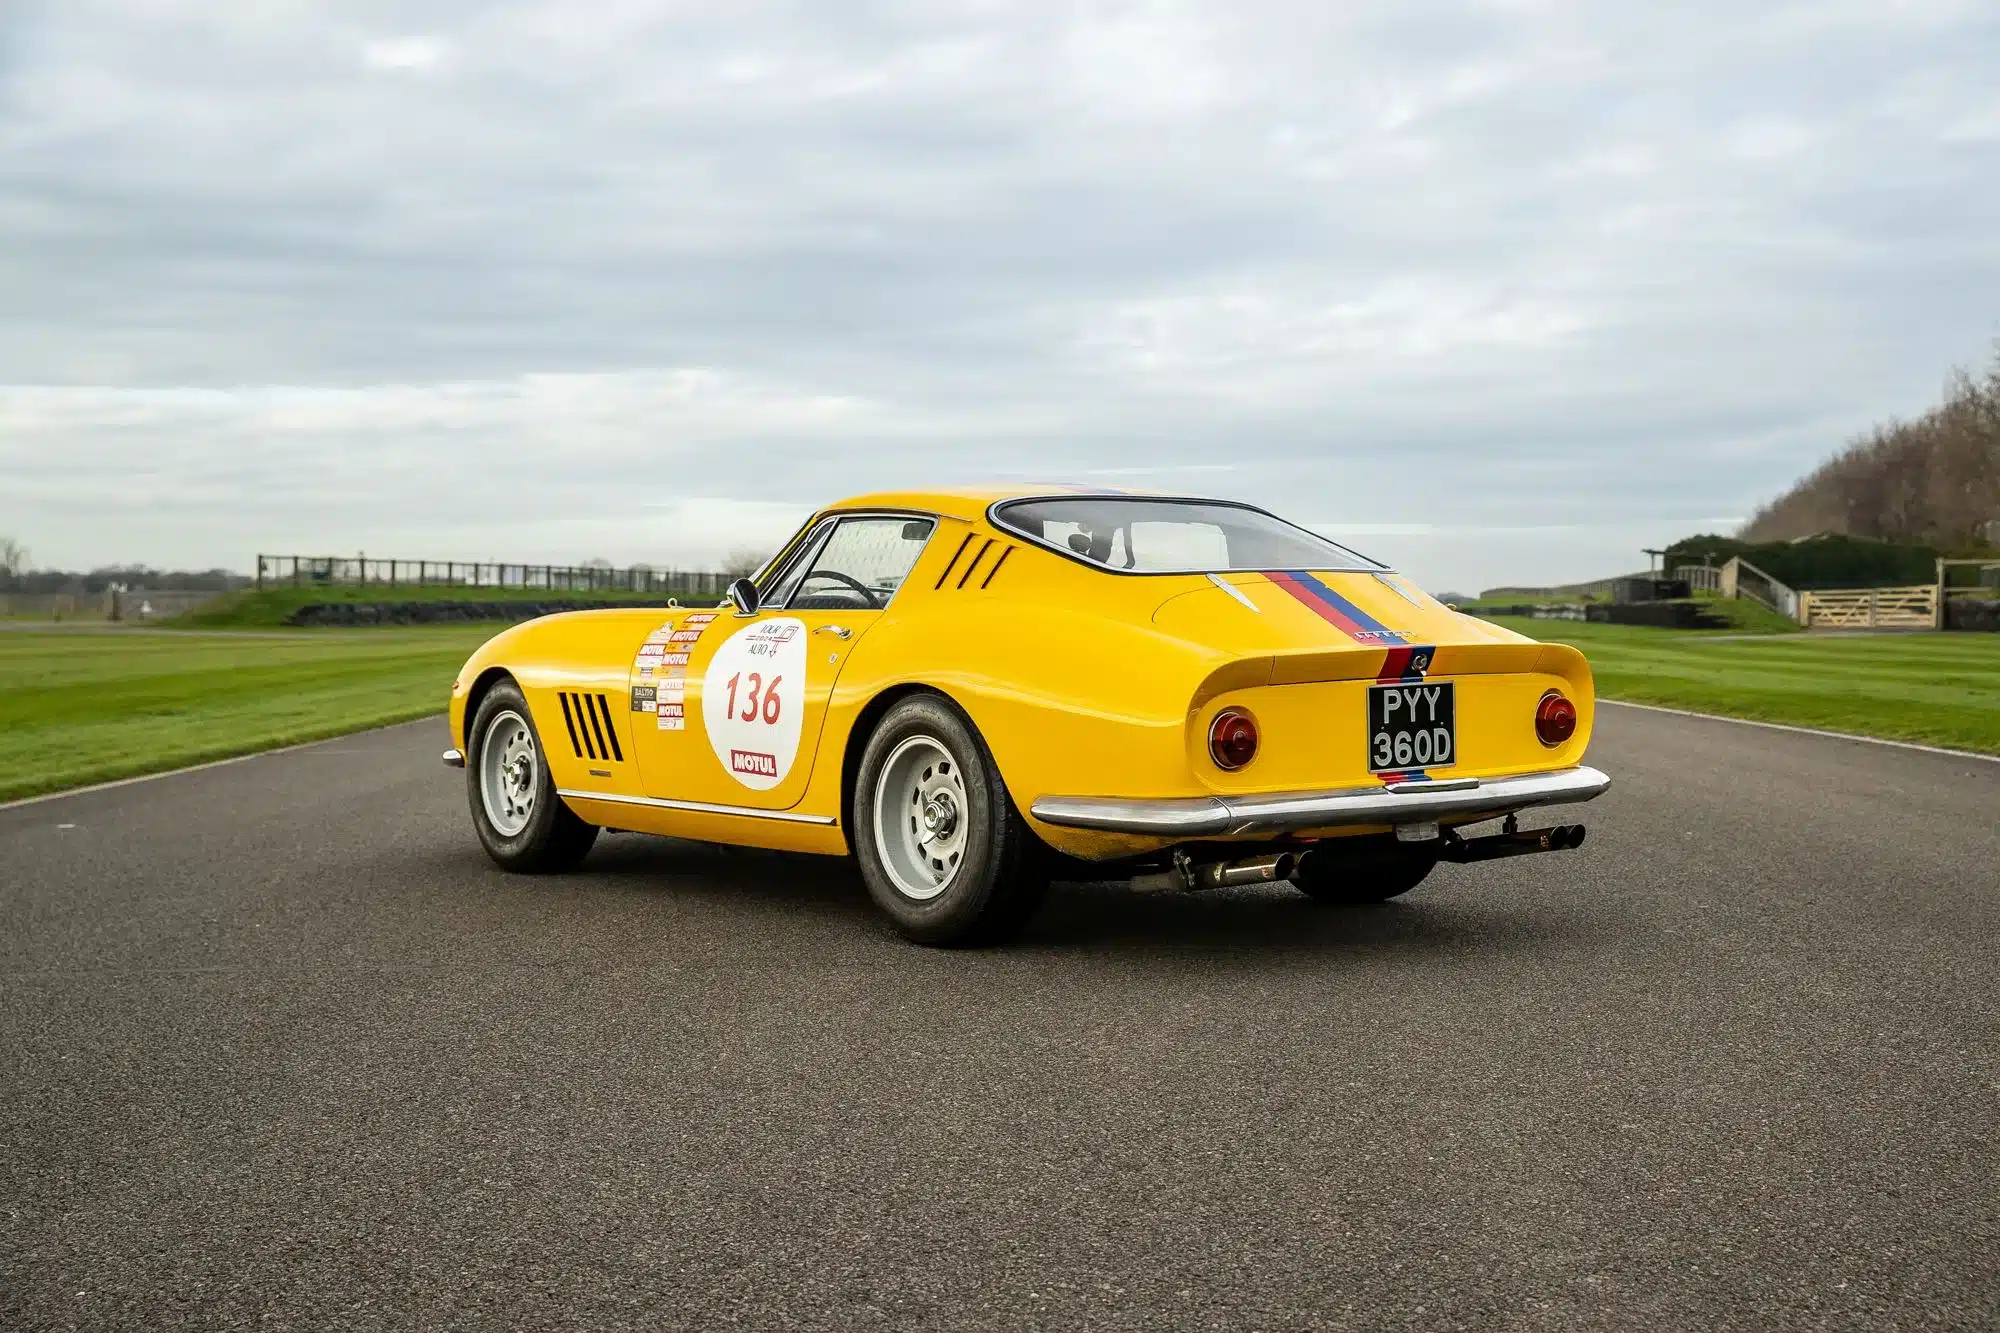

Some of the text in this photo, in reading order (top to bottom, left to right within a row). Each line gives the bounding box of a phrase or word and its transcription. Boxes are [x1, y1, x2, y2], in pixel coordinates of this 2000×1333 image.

[671, 631, 700, 641] MOTUL
[640, 645, 665, 655] MOTUL
[661, 653, 688, 665] MOTUL
[727, 671, 782, 725] 136
[1383, 686, 1441, 724] PYY
[658, 705, 683, 717] MOTUL
[1373, 727, 1451, 767] 360D
[733, 753, 776, 774] MOTUL
